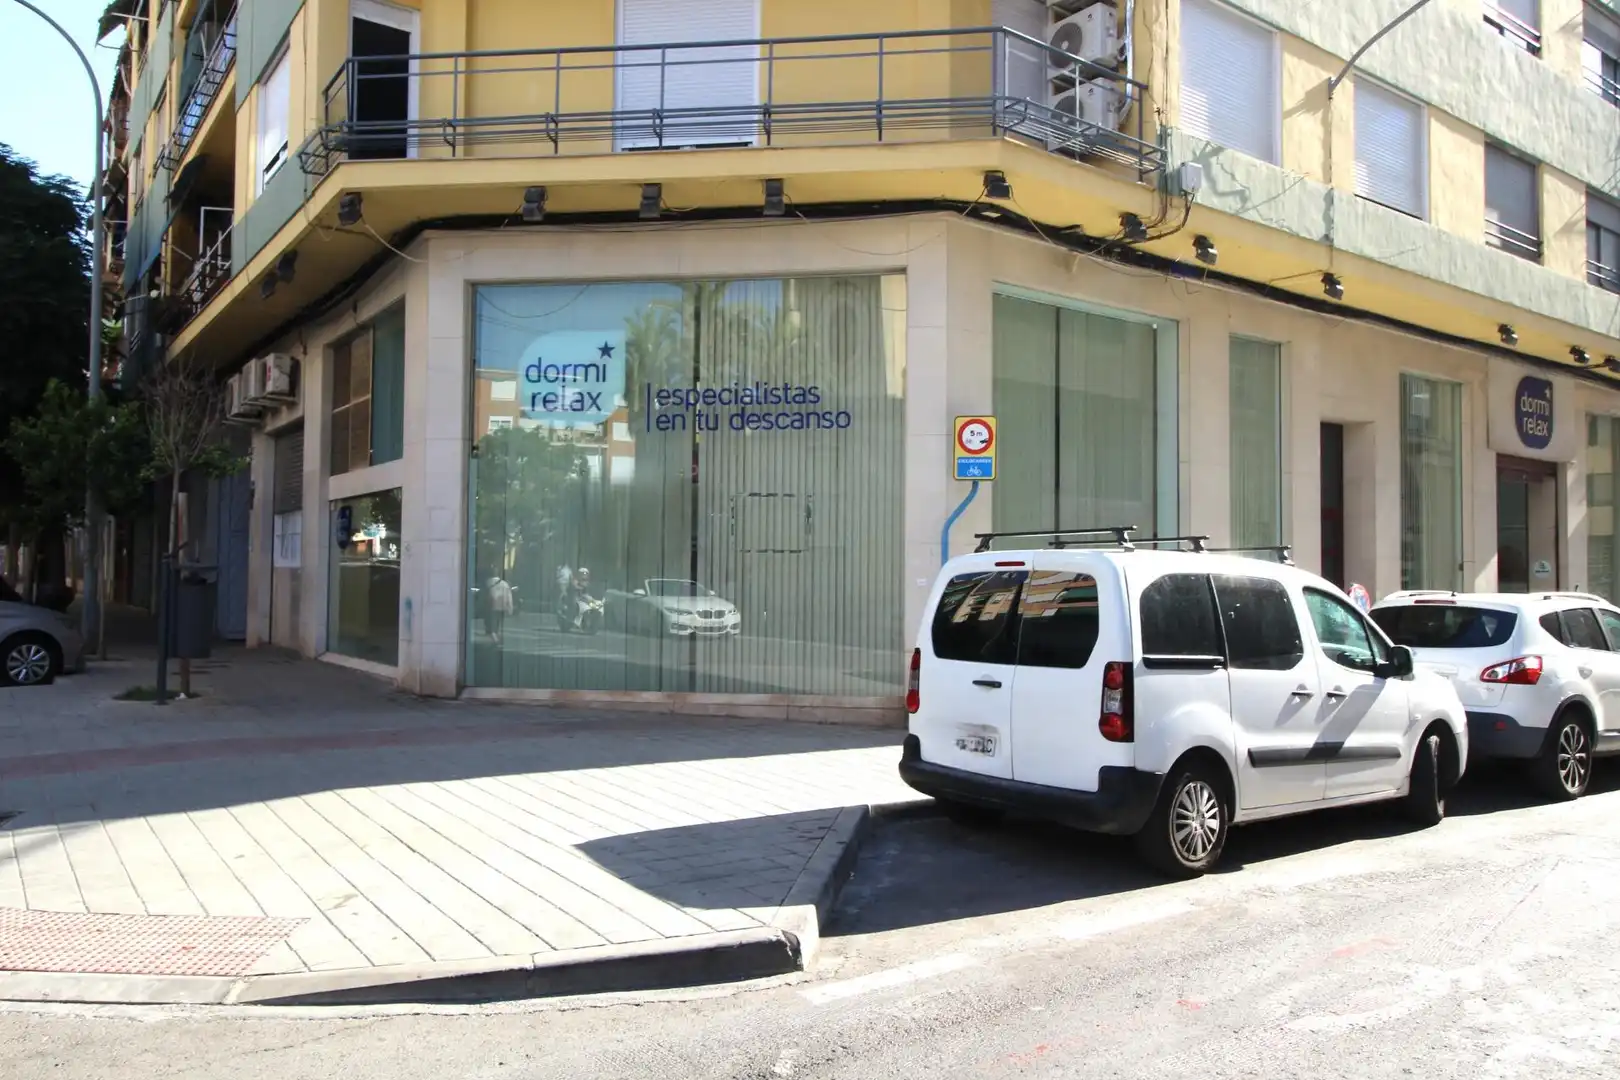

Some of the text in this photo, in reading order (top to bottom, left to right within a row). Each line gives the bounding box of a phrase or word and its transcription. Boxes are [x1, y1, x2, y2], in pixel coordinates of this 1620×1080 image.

[525, 355, 607, 384] dormi
[531, 385, 602, 412] relax
[656, 381, 821, 412] especialistas
[1520, 391, 1550, 417] dormi
[656, 406, 851, 431] en tu descanso
[1523, 414, 1549, 437] relax
